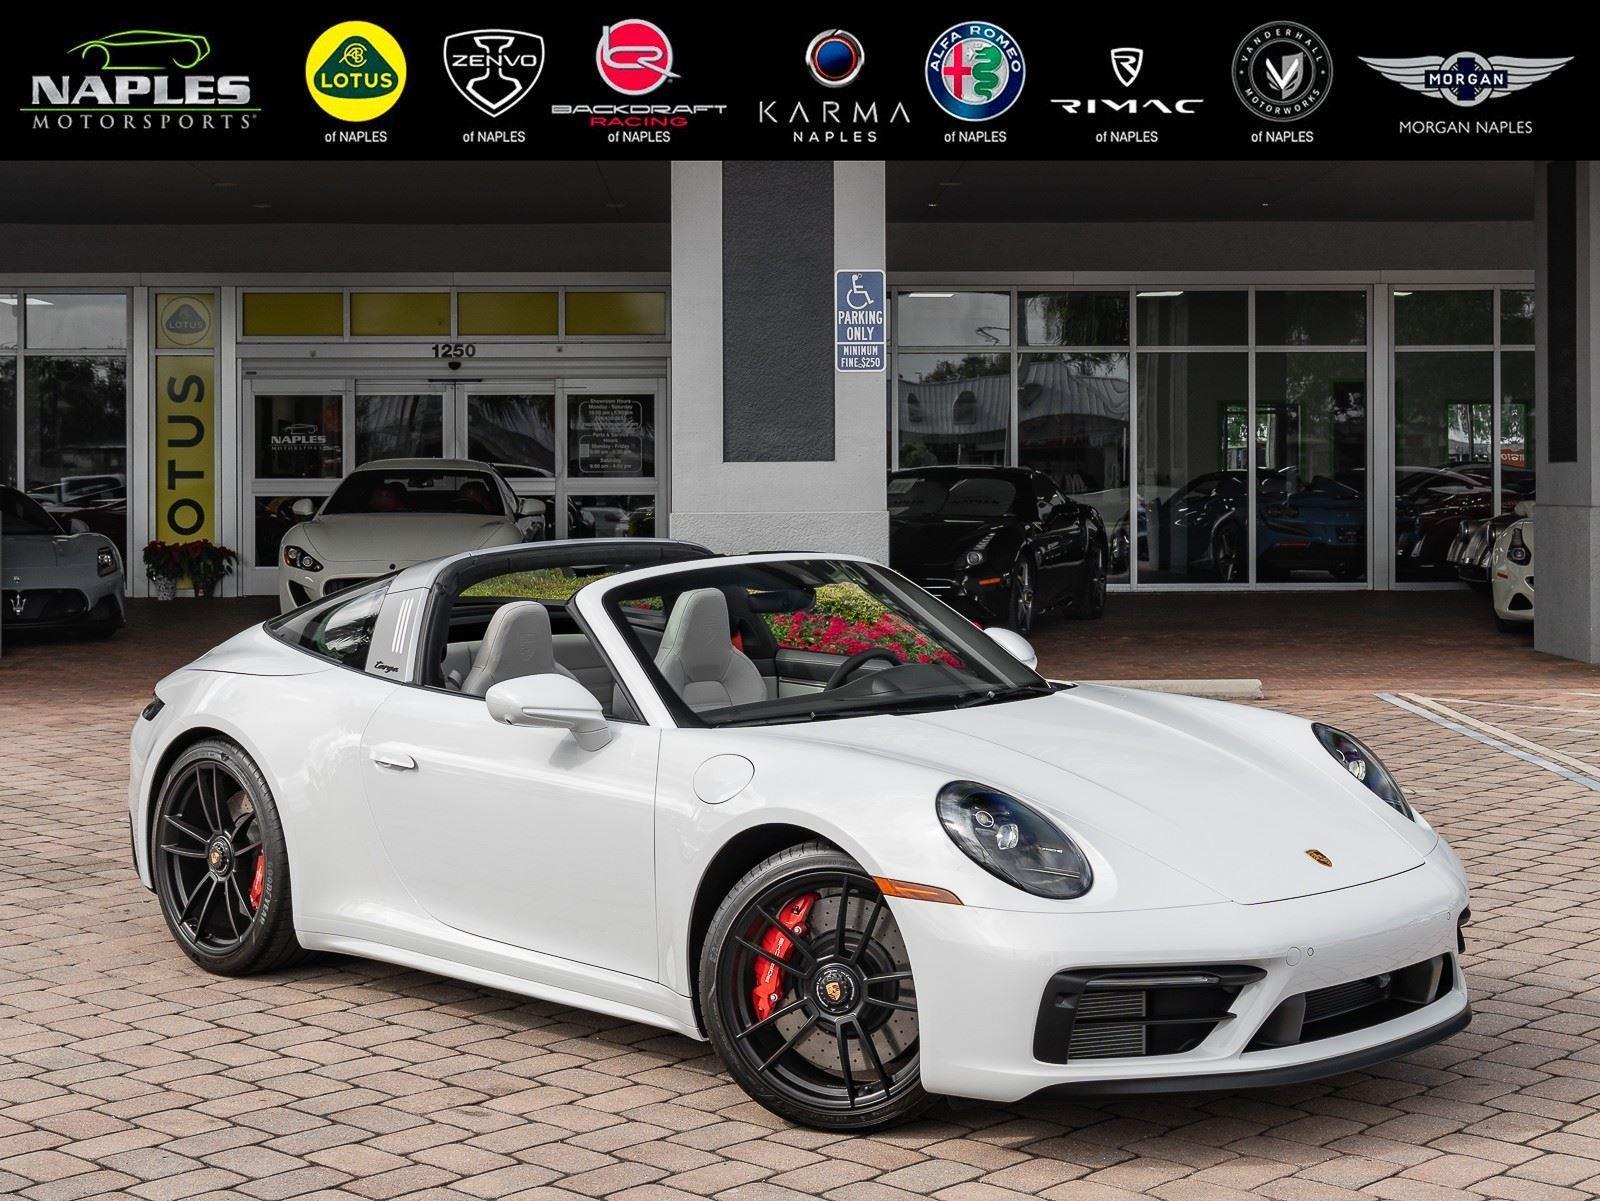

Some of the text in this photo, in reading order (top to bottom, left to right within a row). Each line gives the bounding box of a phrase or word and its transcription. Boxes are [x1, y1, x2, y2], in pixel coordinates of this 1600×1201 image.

[169, 320, 203, 329] LOTUS
[838, 310, 883, 325] PARKING
[846, 326, 875, 341] ONLY
[431, 343, 477, 358] 1250
[843, 345, 878, 356] MINIMUM
[841, 357, 881, 369] FINE $250
[271, 435, 327, 444] NAPLES
[166, 374, 206, 537] OTUS
[373, 660, 400, 673] Targa
[764, 937, 785, 984] PORCHE
